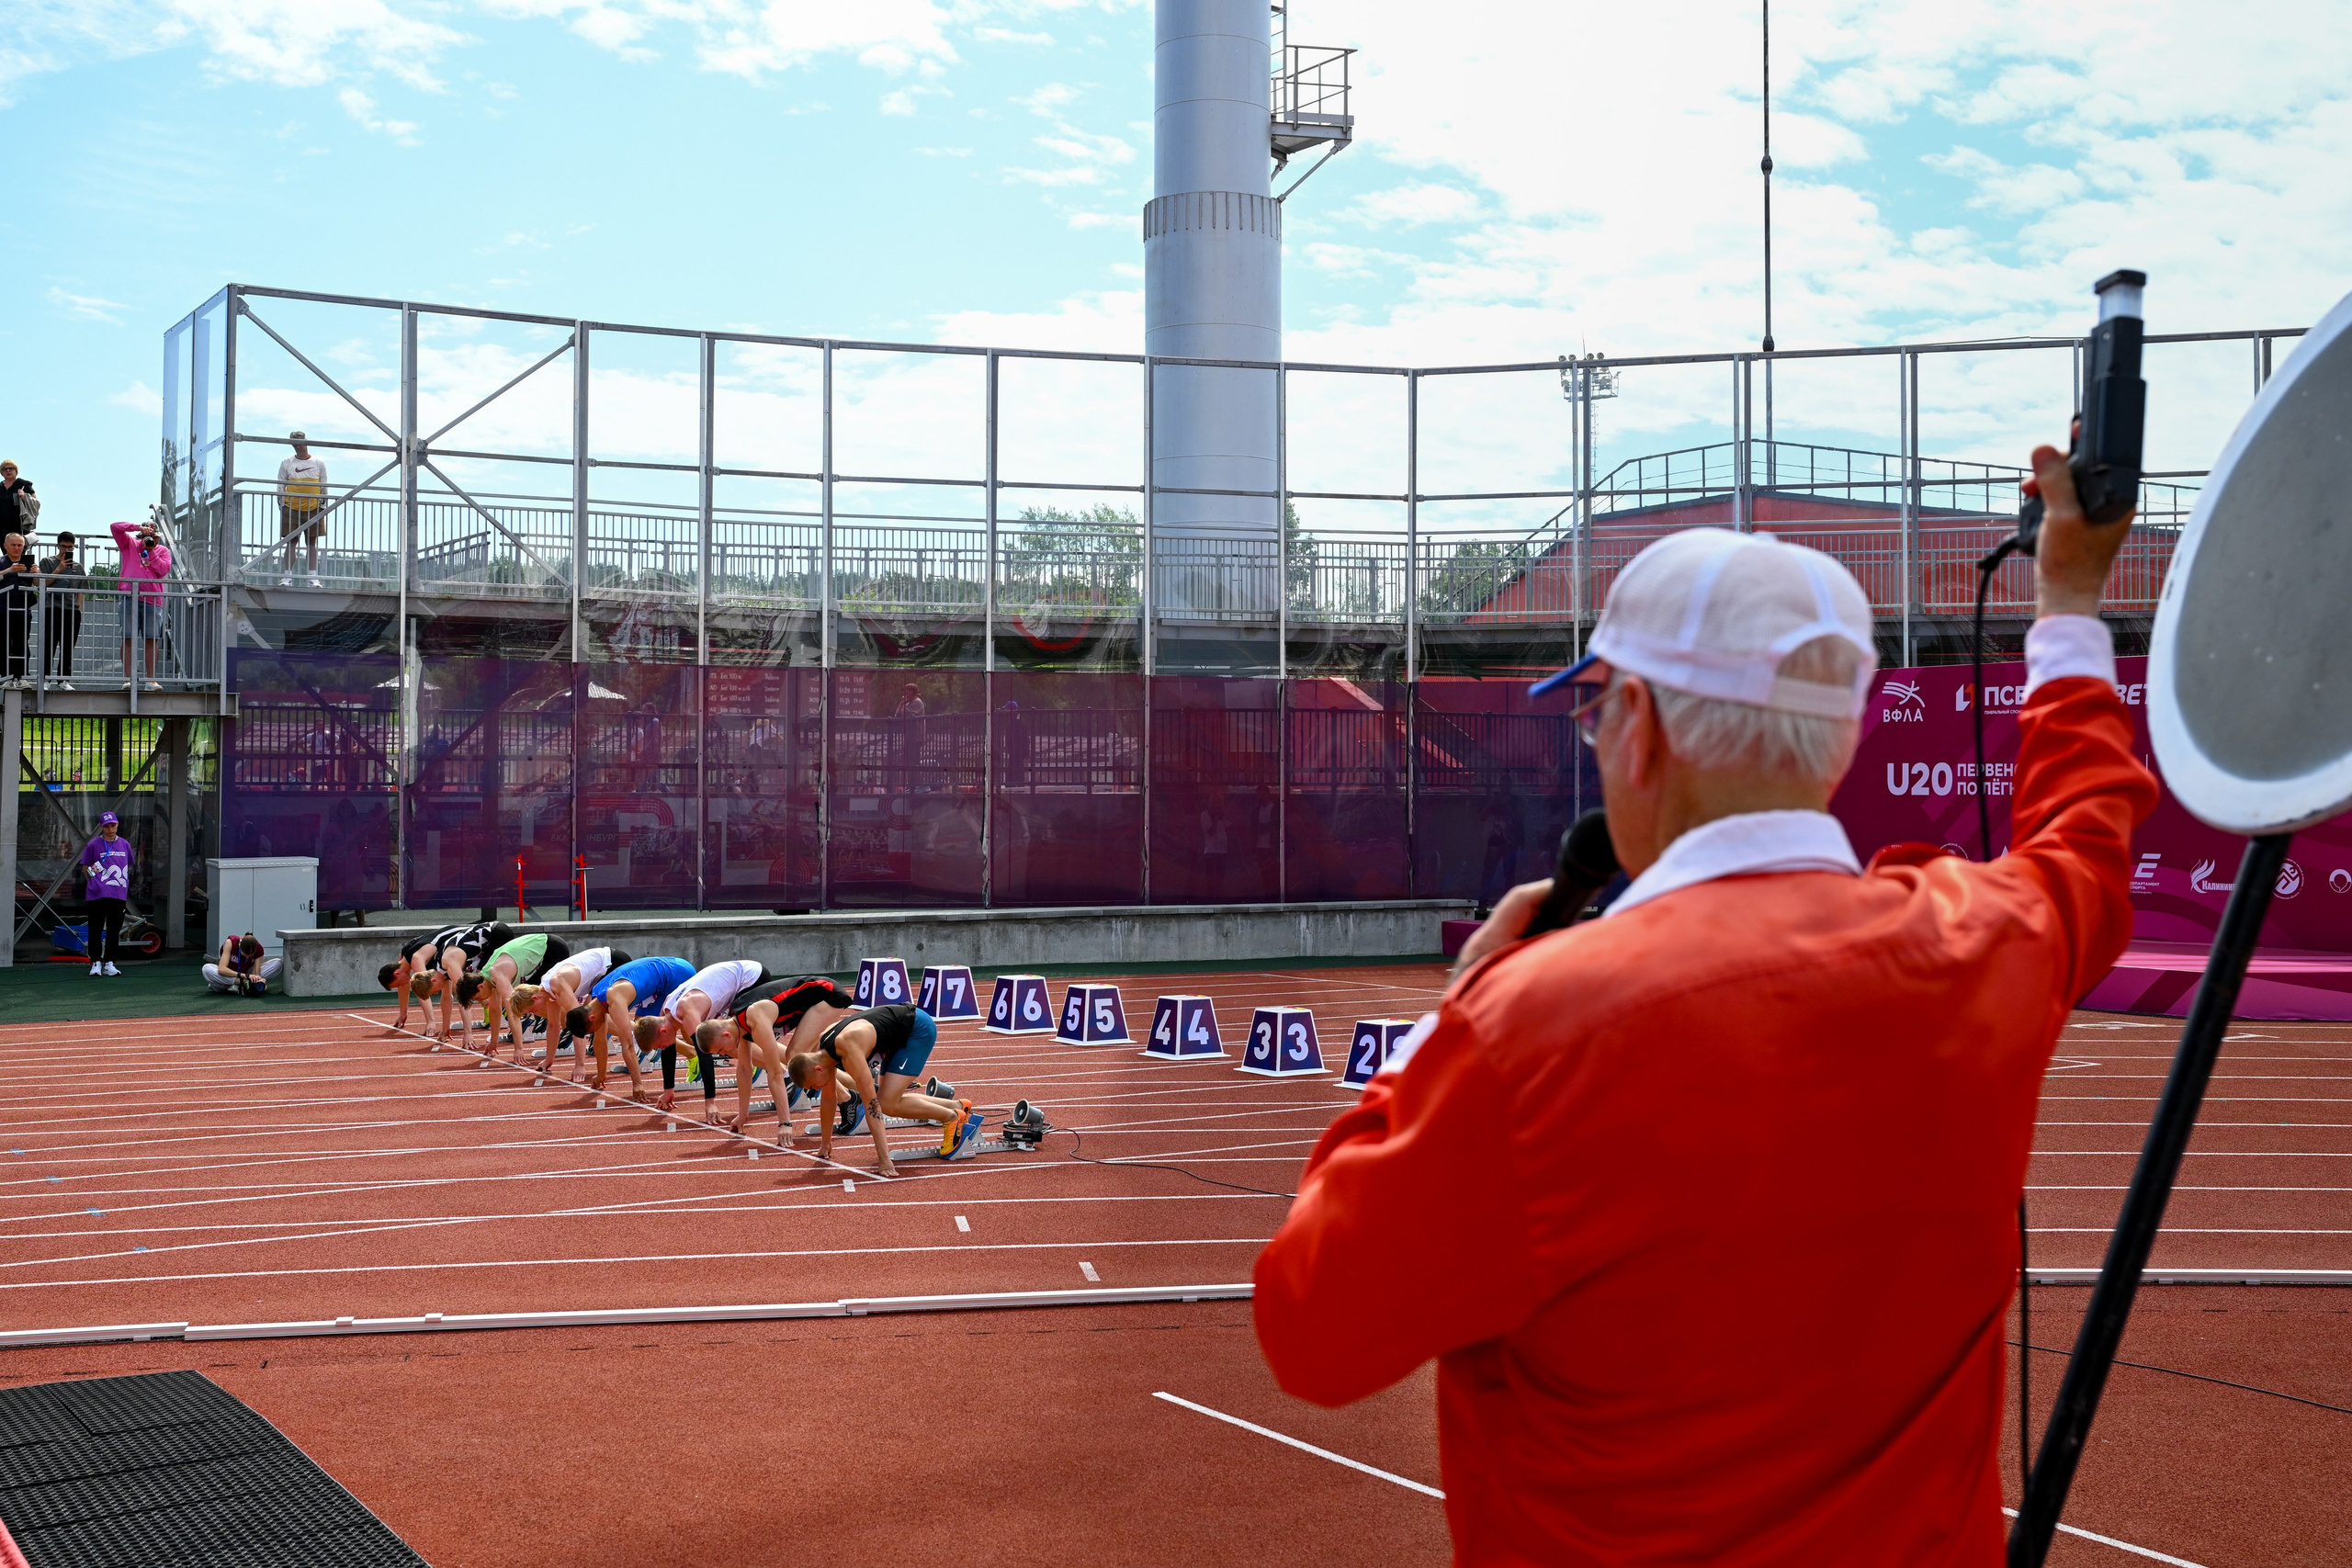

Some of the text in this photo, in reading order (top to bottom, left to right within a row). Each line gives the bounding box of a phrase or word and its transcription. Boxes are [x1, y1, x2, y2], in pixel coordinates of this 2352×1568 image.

[1883, 708, 1924, 723] ВФЛА
[1887, 762, 1953, 796] U20
[1958, 783, 1977, 795] ПО
[859, 969, 871, 999] 8
[882, 970, 901, 999] 8
[923, 977, 935, 1009] 7
[946, 977, 966, 1009] 7
[995, 987, 1008, 1021] 6
[1023, 988, 1043, 1021] 6
[1066, 997, 1082, 1031] 5
[1094, 998, 1115, 1032] 5
[1155, 1010, 1171, 1045] 4
[1187, 1009, 1209, 1045] 4
[1253, 1021, 1272, 1060] 3
[1287, 1022, 1309, 1061] 3
[1355, 1034, 1376, 1075] 2
